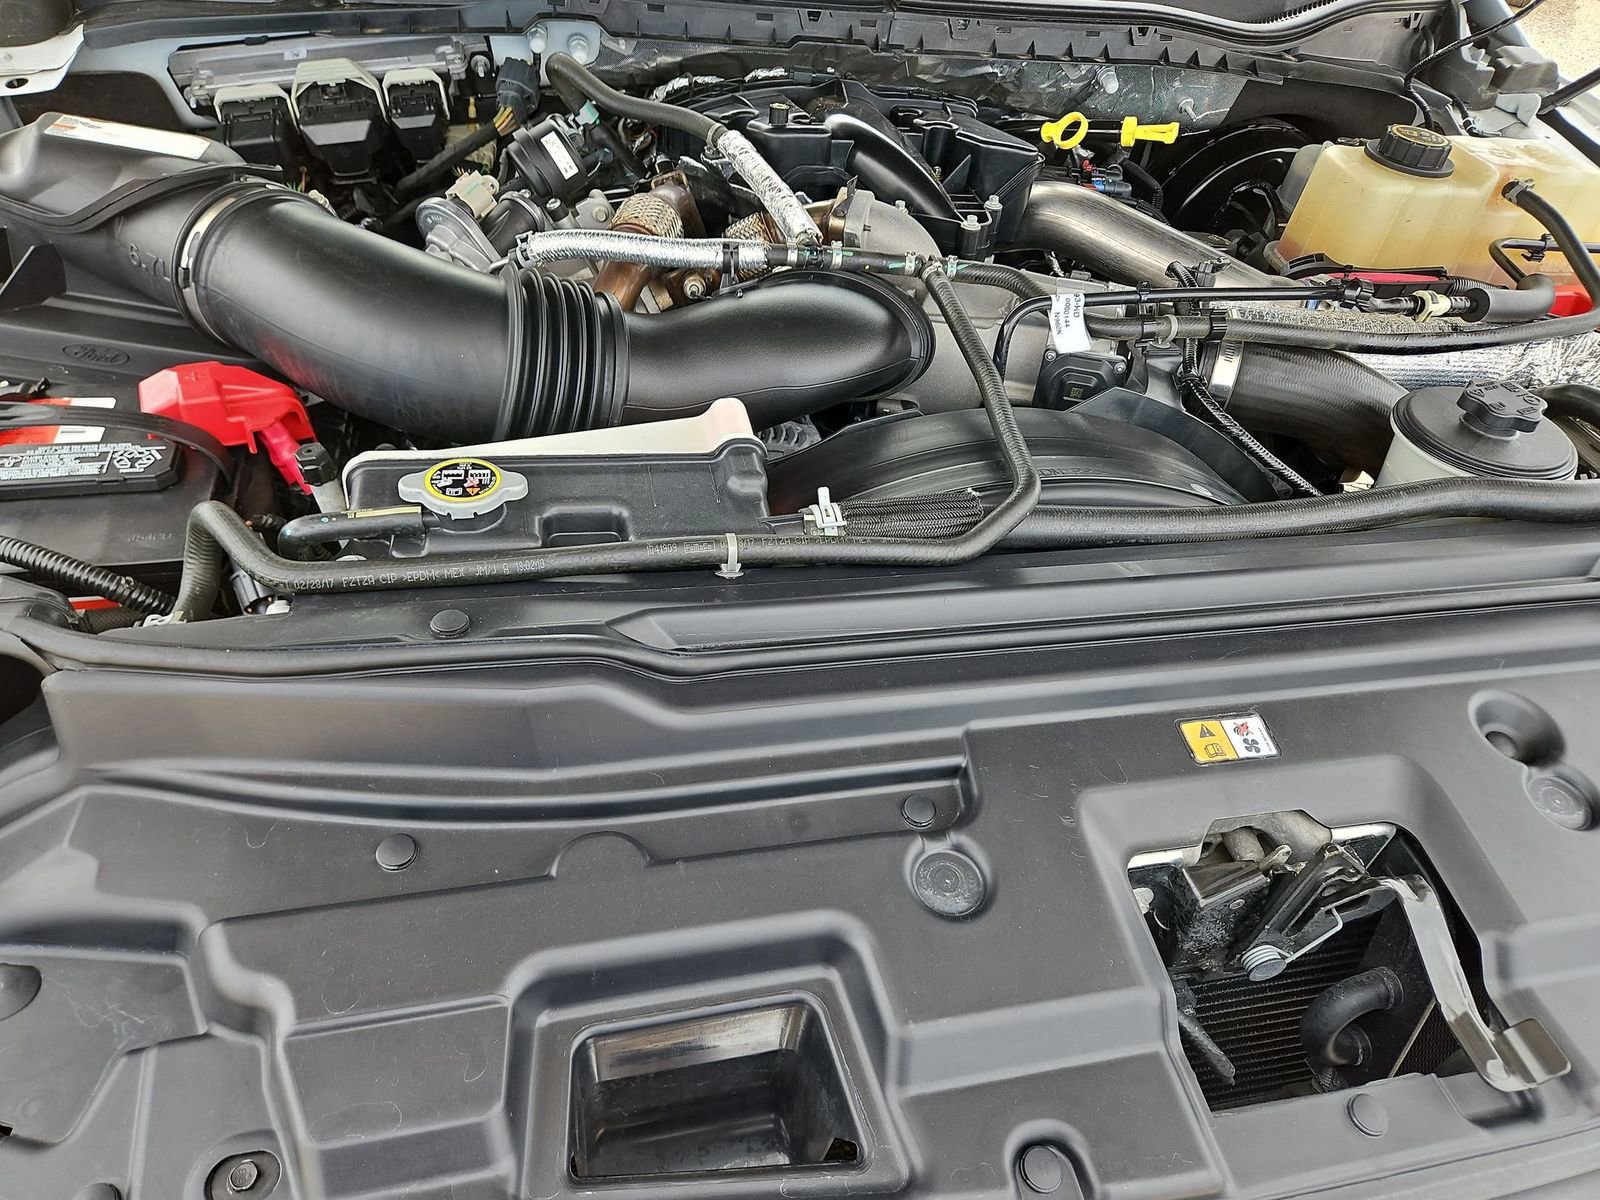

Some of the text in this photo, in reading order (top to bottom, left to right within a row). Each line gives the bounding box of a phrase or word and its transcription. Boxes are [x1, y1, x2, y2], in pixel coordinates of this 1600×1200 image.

[130, 243, 170, 282] 6.7L
[73, 345, 121, 363] Ford
[293, 578, 335, 590] 02/28/17
[444, 567, 465, 579] MEX
